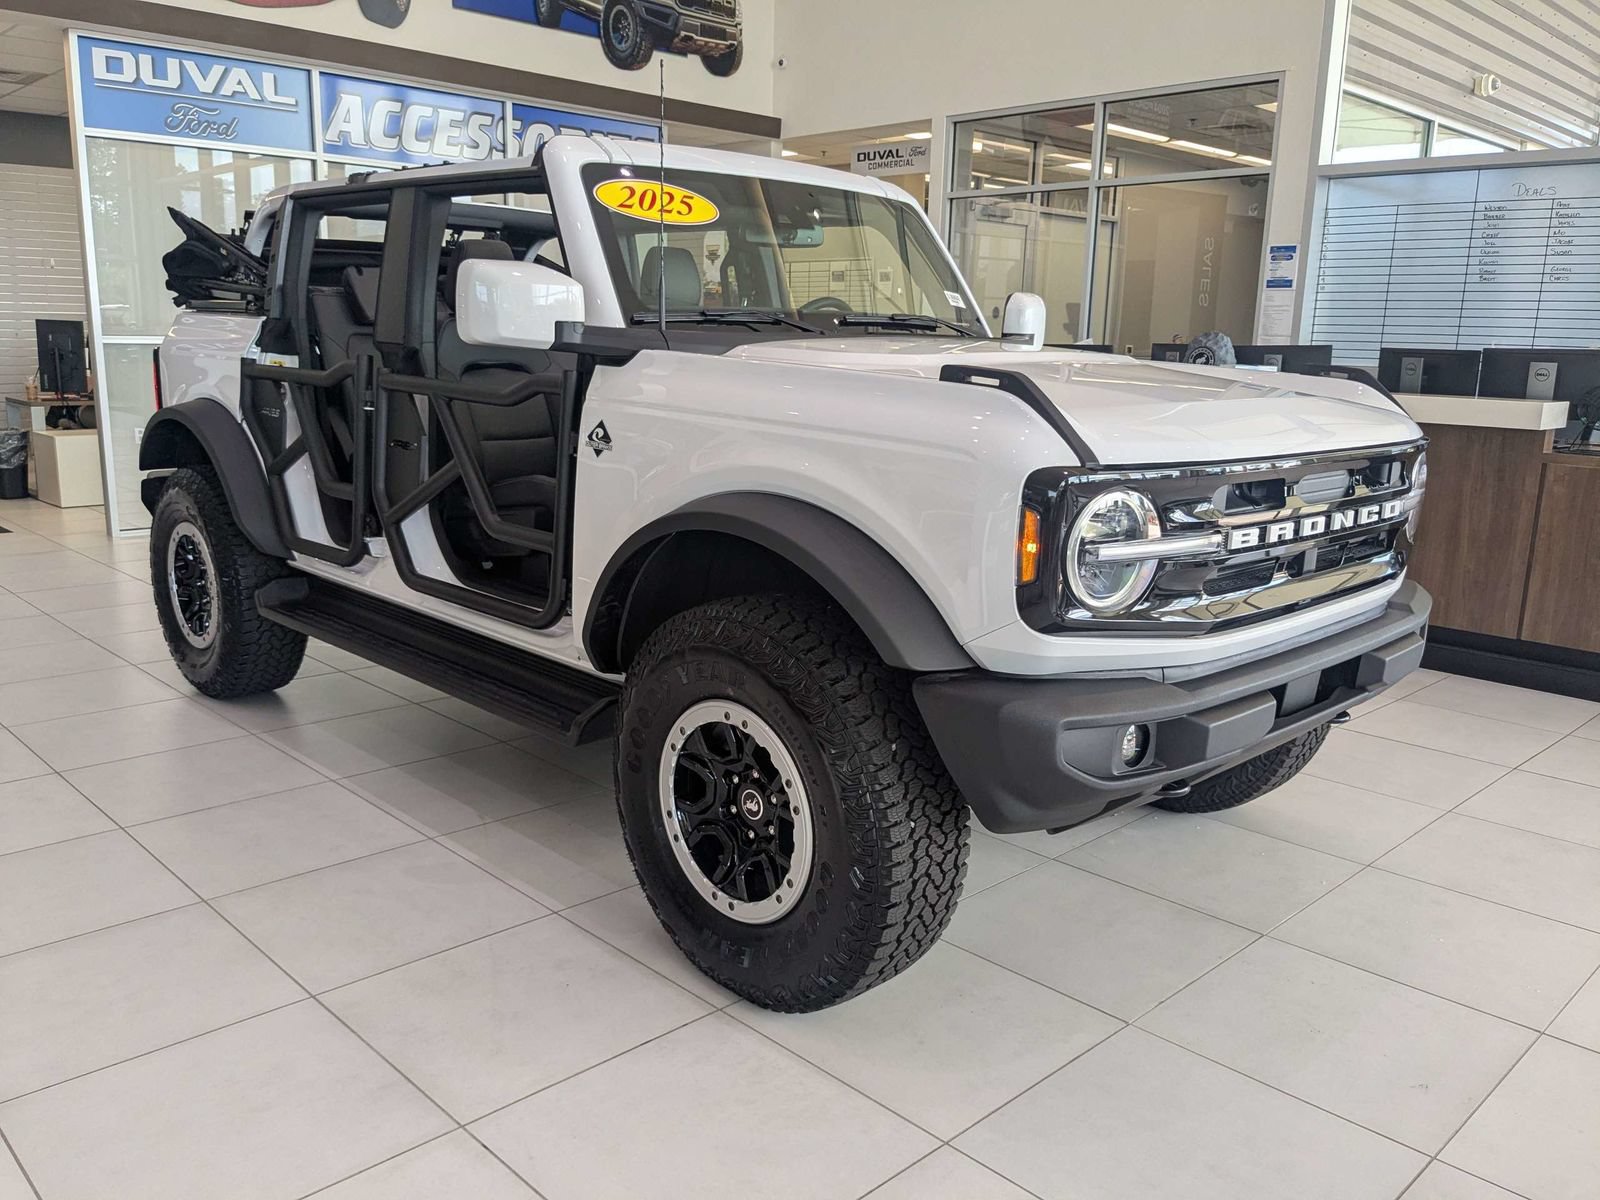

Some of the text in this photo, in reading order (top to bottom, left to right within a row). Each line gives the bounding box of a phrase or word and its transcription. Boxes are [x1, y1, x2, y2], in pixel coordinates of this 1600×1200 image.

[92, 47, 297, 106] DUVAL
[164, 103, 239, 140] Ford
[324, 94, 655, 160] ACCESSO
[857, 146, 927, 162] DUVAL Ford
[868, 159, 915, 170] COMMERCIAL
[617, 186, 694, 216] 2025
[1512, 182, 1557, 197] DEALS
[1229, 500, 1402, 550] BRONCO
